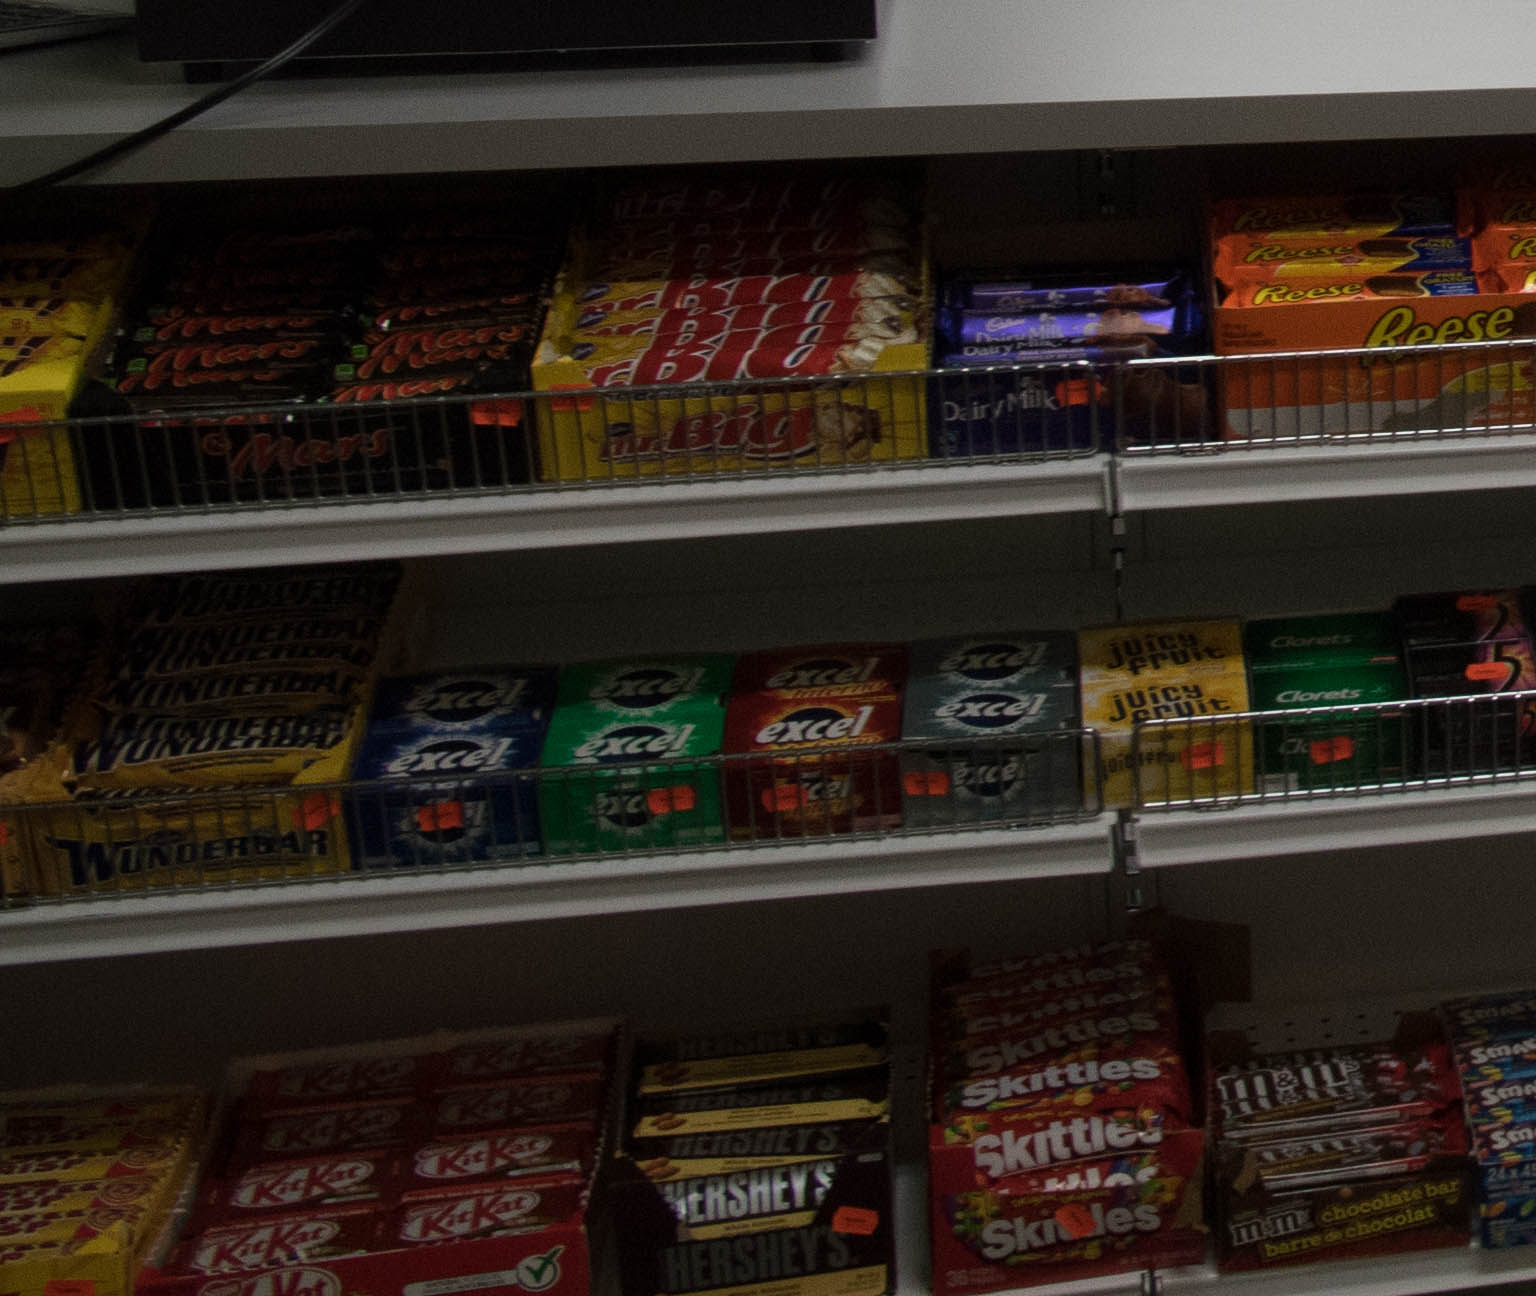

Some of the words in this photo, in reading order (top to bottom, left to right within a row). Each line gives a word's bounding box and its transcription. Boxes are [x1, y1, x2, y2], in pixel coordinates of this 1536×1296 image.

[1243, 244, 1354, 263] Reese
[1253, 282, 1363, 306] Reese
[1360, 305, 1515, 367] Reese
[943, 399, 1003, 423] Dairy
[937, 641, 1050, 672] excel
[1106, 631, 1199, 670] juicy
[1270, 634, 1353, 649] Clorets
[765, 656, 882, 690] excel
[1128, 644, 1227, 676] fruit
[406, 678, 530, 713] excel
[590, 666, 707, 699] excel
[1275, 687, 1363, 705] Clorets
[934, 693, 1050, 718] excel
[1109, 683, 1204, 723] juicy
[573, 722, 698, 758] excel
[754, 705, 875, 745] excel
[387, 735, 517, 774] excel
[960, 1057, 1162, 1108] Skittles
[974, 1112, 1164, 1178] Skittles
[664, 1158, 836, 1226] HERSHEY'S
[1320, 1185, 1422, 1225] chocolate
[1424, 1178, 1461, 1197] bar
[980, 1202, 1162, 1259] Skiles
[1264, 1236, 1321, 1257] barre
[1348, 1204, 1436, 1237] chocolat
